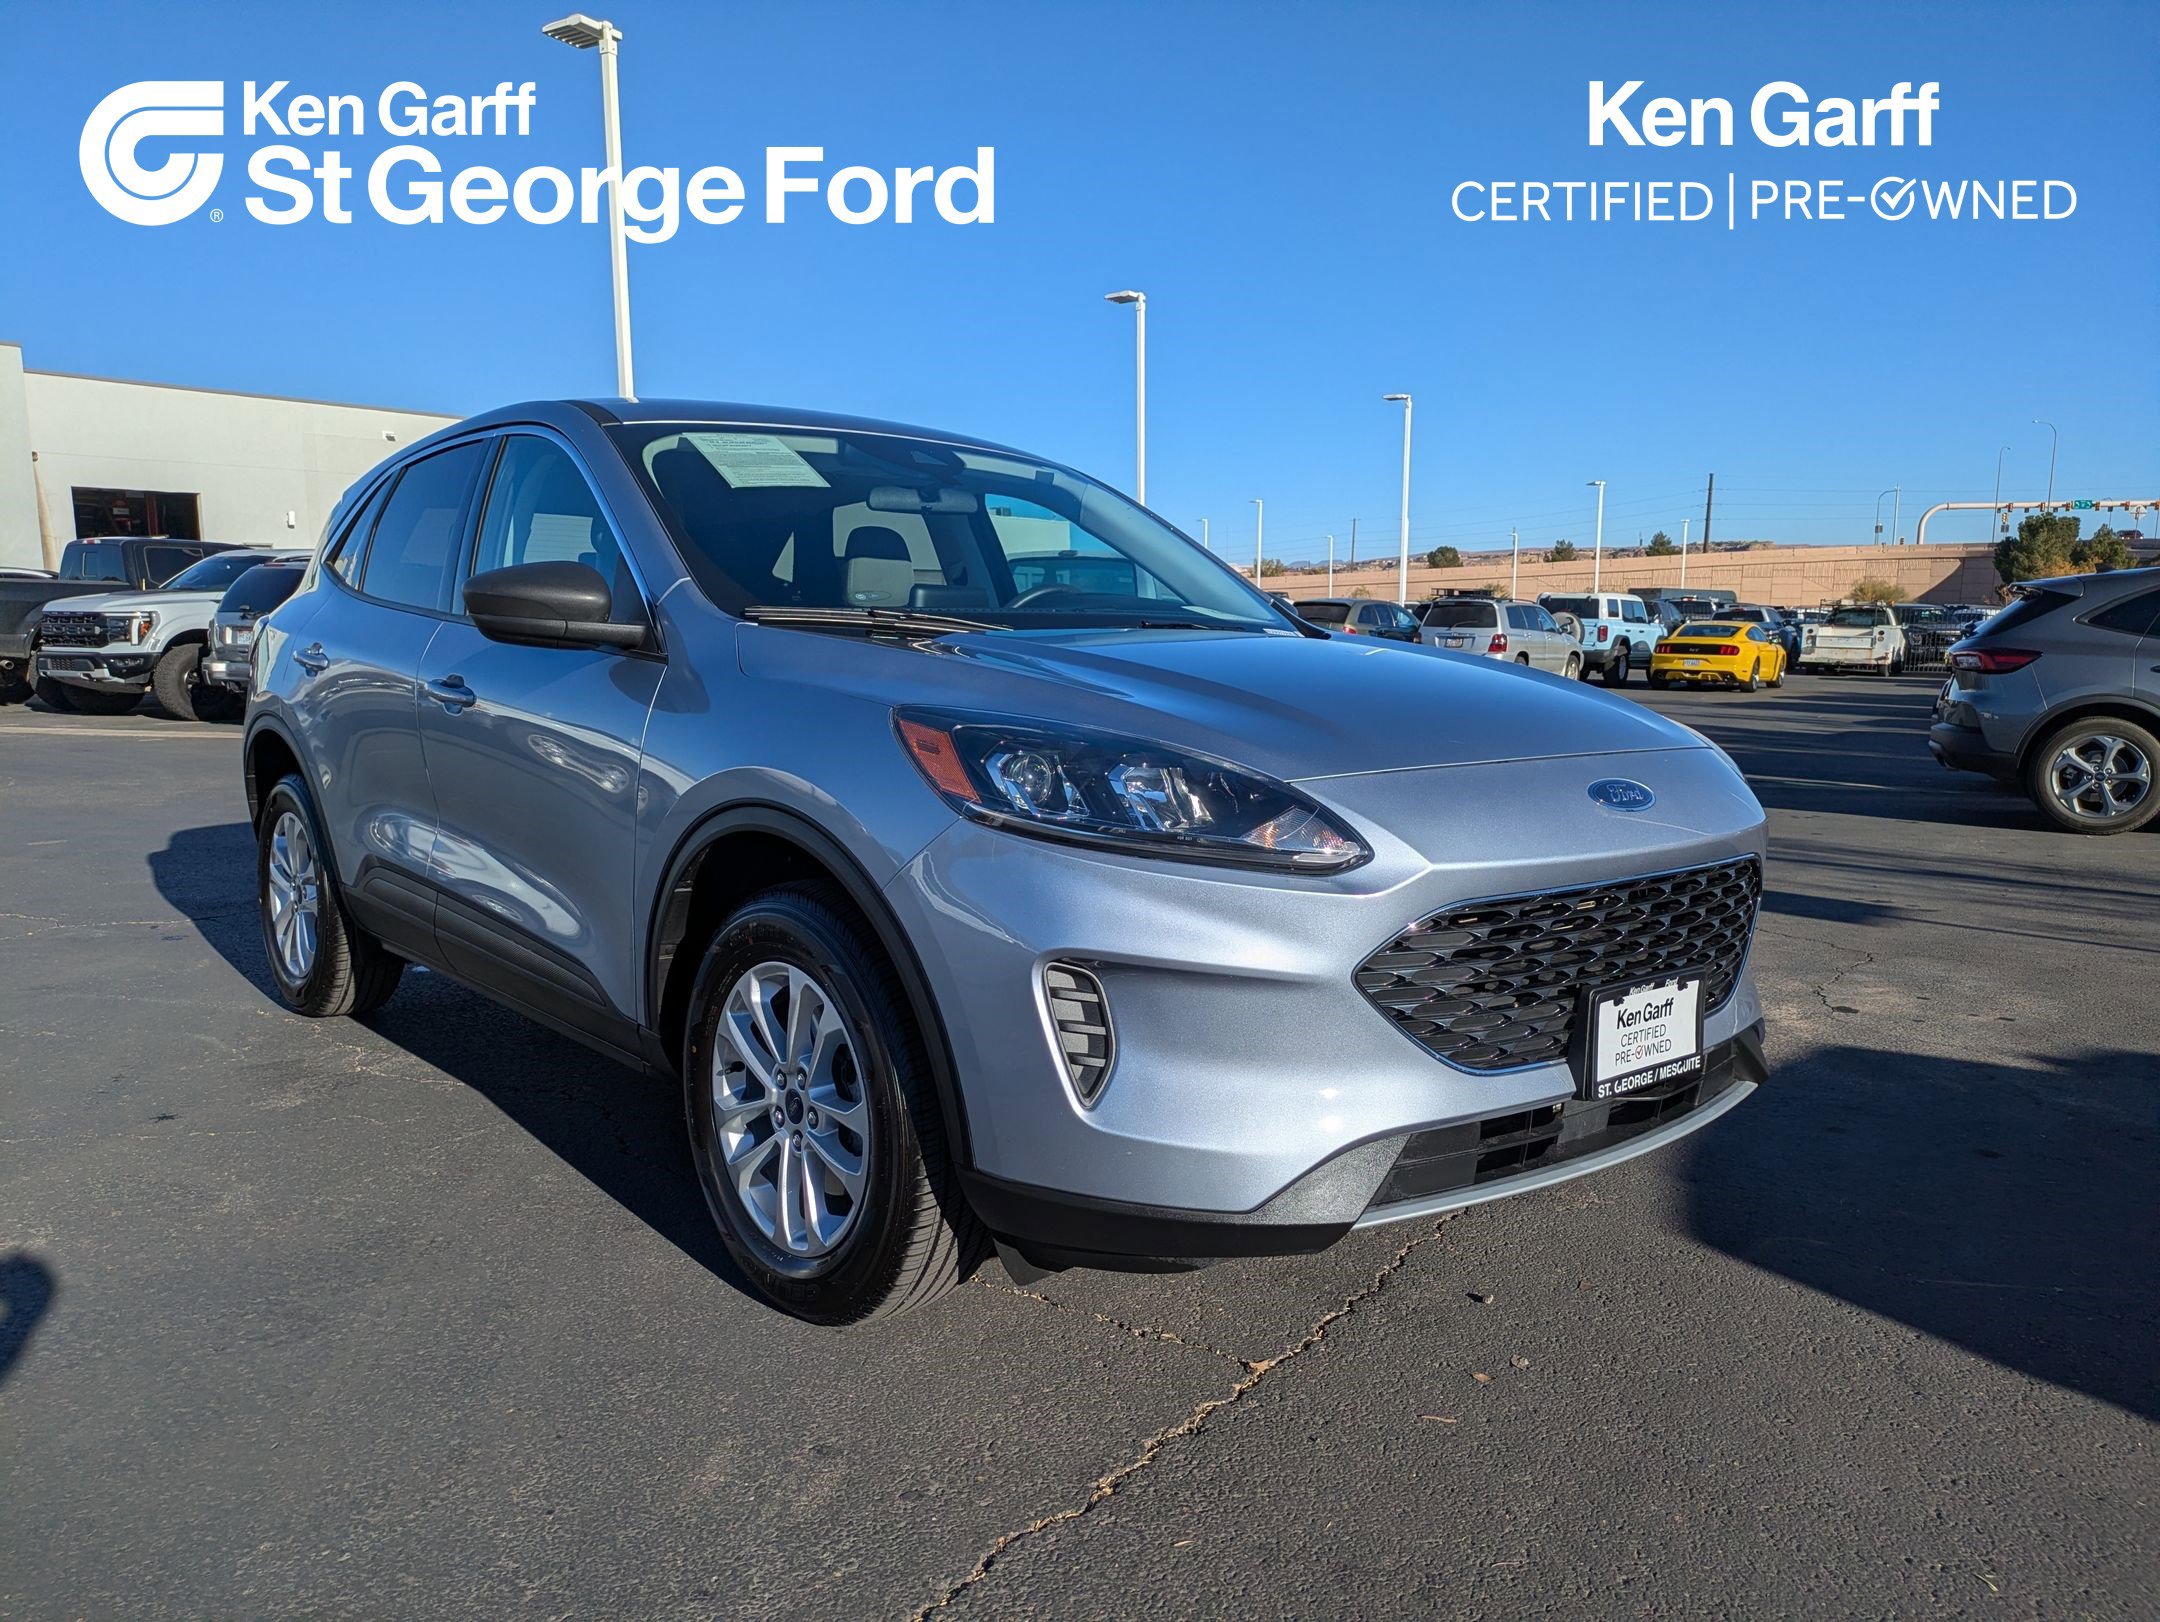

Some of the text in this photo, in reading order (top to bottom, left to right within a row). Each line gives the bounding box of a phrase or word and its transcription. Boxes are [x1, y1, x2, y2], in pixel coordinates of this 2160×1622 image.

[1616, 997, 1674, 1030] Ken Garff
[1620, 1024, 1667, 1047] CERTIFIED
[1597, 1084, 1612, 1098] ST.
[1614, 1071, 1653, 1094] GEORGE
[1659, 1056, 1701, 1079] MESQUITE
